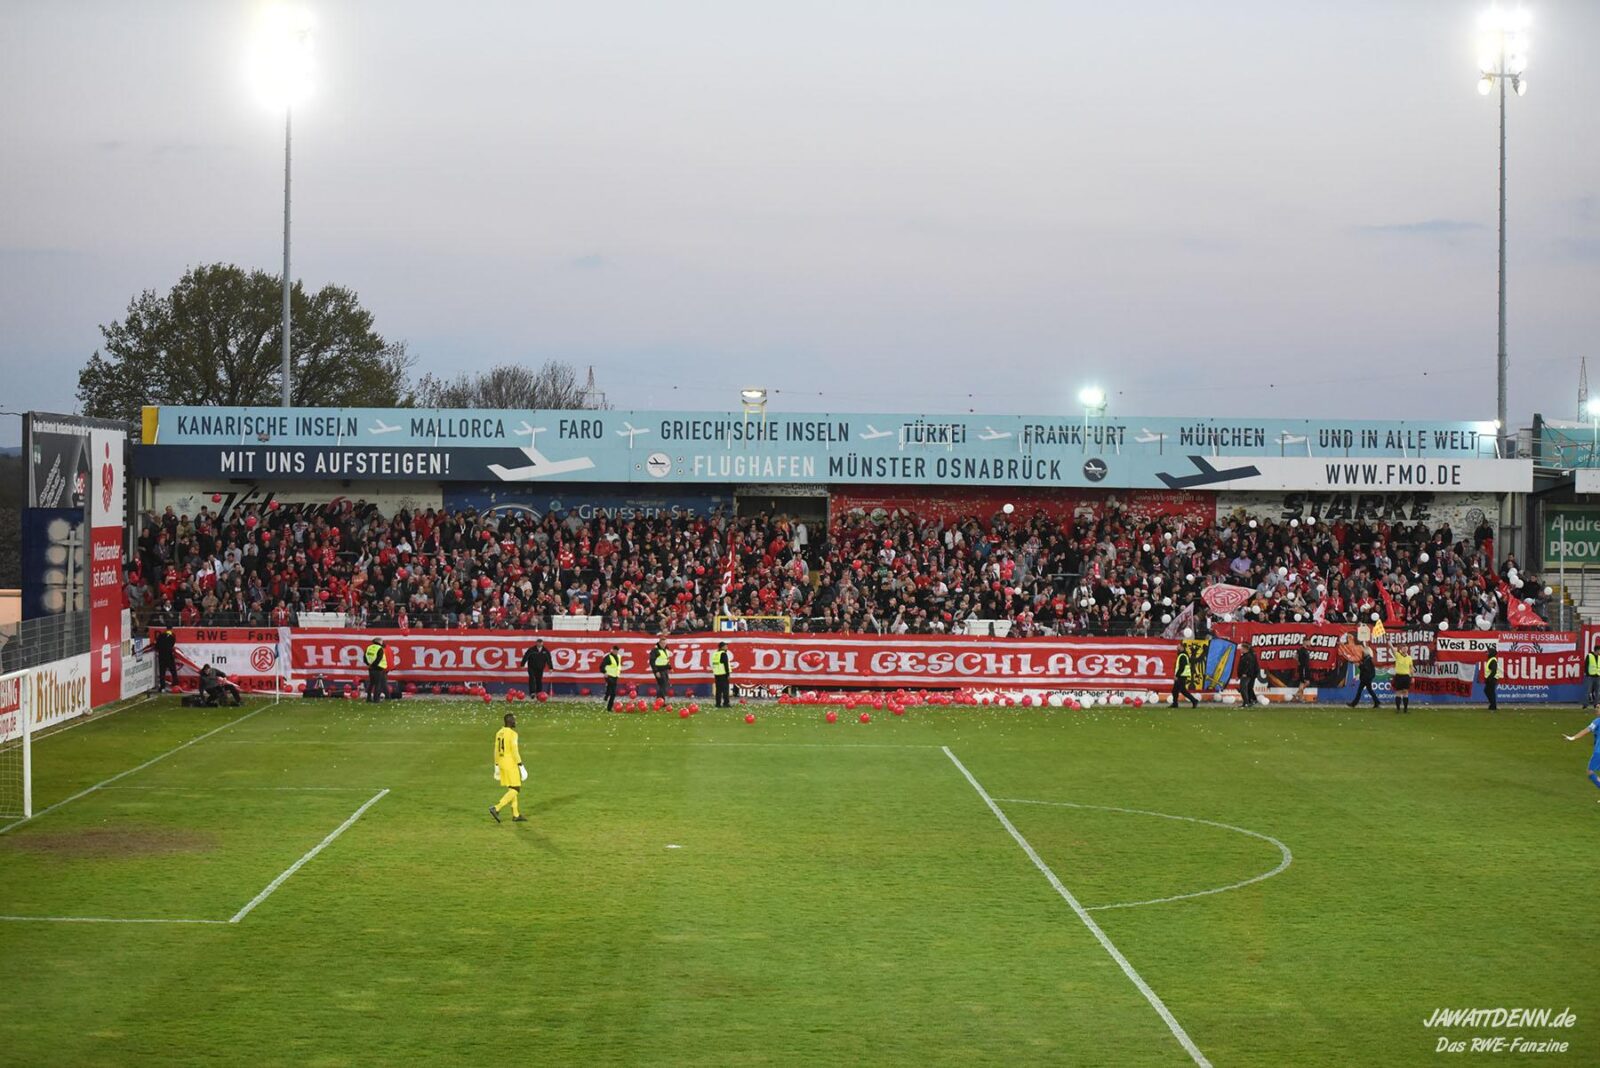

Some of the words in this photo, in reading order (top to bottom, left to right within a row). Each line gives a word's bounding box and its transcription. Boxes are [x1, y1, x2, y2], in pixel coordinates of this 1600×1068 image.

[178, 416, 288, 436] KANARISCHE
[296, 417, 357, 437] INSELN
[410, 418, 505, 438] MALLORCA
[559, 419, 603, 439] FARO
[661, 421, 778, 441] GRIECHISCHE
[786, 422, 849, 442] INSELN
[904, 422, 966, 443] TÜRKEI
[1024, 425, 1126, 445] FRANKFURT
[1180, 425, 1265, 447] MÜNCHEN
[1319, 428, 1353, 448] UND
[1361, 429, 1378, 448] IN
[1385, 429, 1426, 449] ALLE
[1433, 431, 1479, 450] WELT
[221, 452, 256, 472] MIT
[266, 452, 305, 473] UNS
[315, 453, 450, 474] AUFSTEIGEN!
[694, 455, 815, 477] FLUGHAFEN
[829, 453, 925, 478] MÜNSTER
[936, 454, 1061, 480] OSNABRÜCK
[1326, 464, 1461, 485] WWW.FMO.DE
[672, 504, 695, 519] SE
[1281, 493, 1435, 520] STARKE
[1550, 541, 1600, 557] PROV
[197, 630, 228, 641] RWE
[248, 630, 280, 641] Fans
[1251, 633, 1306, 647] NORTHSIDE
[1310, 634, 1338, 647] CREW
[1438, 639, 1465, 650] West
[1502, 633, 1529, 641] WAHRE
[1531, 634, 1569, 642] FUSSBALL
[212, 653, 227, 664] im
[751, 648, 858, 673] DICH
[871, 651, 1166, 676] GESCHLAGEN
[1261, 650, 1276, 660] ROT
[1376, 645, 1430, 662] ESEN
[36, 669, 86, 723] Bitburger
